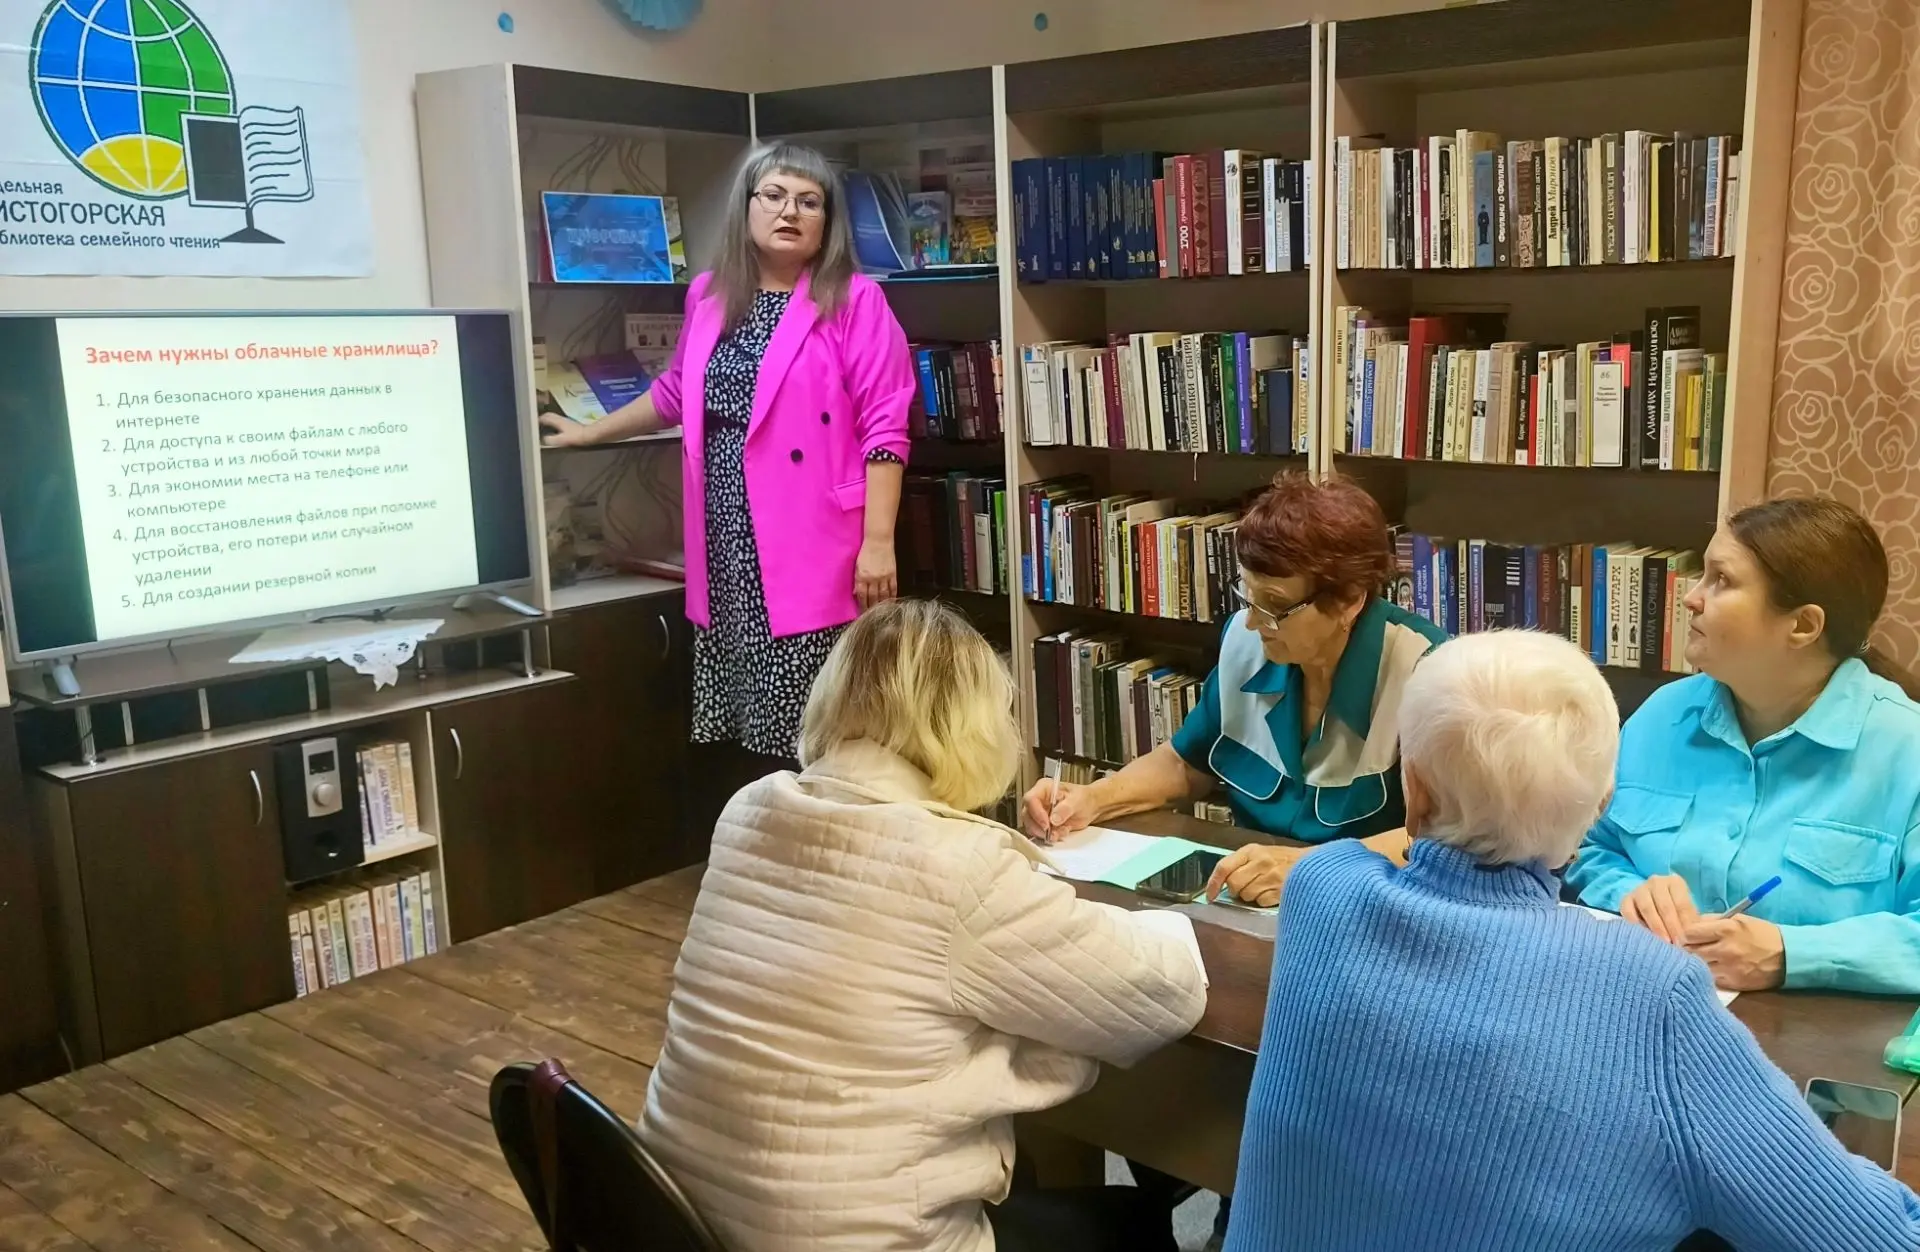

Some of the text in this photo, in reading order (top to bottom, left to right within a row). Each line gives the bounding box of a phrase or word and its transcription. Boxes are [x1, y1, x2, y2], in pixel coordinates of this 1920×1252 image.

[1548, 156, 1558, 240] Андрей Миронов
[80, 231, 165, 247] семейного
[169, 236, 220, 248] чтения
[1180, 226, 1189, 250] 1700
[86, 340, 438, 366] Зачем нужны облачные хранилища?
[96, 385, 392, 408] 1. Для безопасного хранения данных в
[1183, 337, 1200, 449] ПАМЯТНИКИ СИБИРИ
[102, 422, 408, 454] 2. Для доступа к своим файлам с любого
[116, 415, 199, 430] интернете
[121, 446, 380, 477] устройства и из любой точки мира
[108, 464, 408, 499] 3. Для экономии места на телефоне или
[113, 500, 437, 542] 4. Для восстановления файлов при поломке
[128, 500, 226, 518] компьютере
[132, 522, 413, 565] устройства, его потери или случайном
[122, 566, 376, 608] 5. Для создании резервной копии
[135, 566, 211, 587] удалении
[1180, 584, 1190, 618] ИТОГИ
[1611, 565, 1622, 623] ПЛУТАРХ
[1629, 566, 1640, 624] ПЛУТАРХ
[1645, 618, 1657, 655] ПЛУТАРХ
